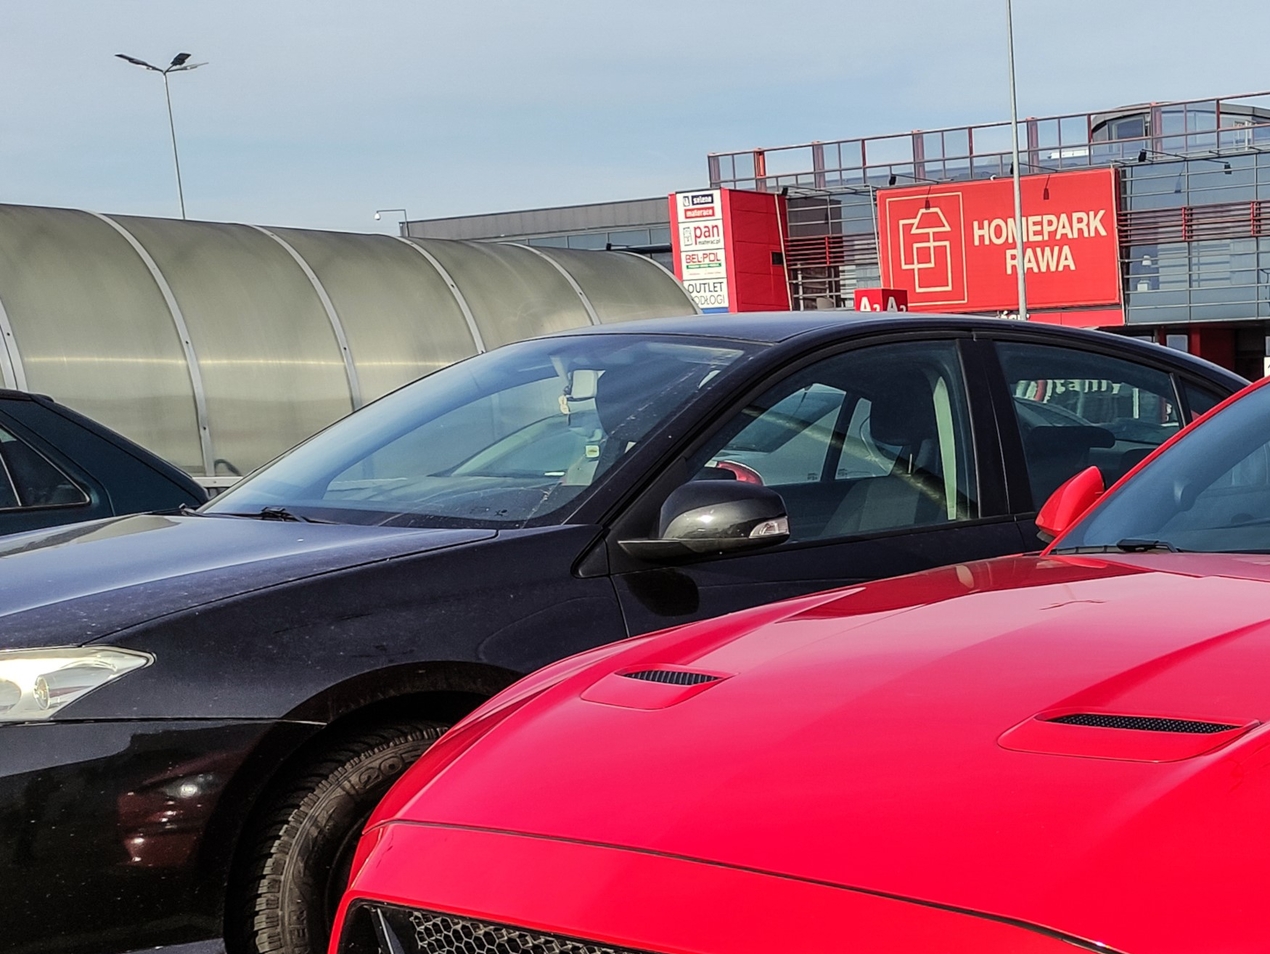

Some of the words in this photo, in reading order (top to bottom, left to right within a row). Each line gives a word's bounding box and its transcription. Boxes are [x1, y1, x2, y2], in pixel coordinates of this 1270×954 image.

[693, 224, 720, 246] pan
[973, 210, 1107, 246] HOMEPARK
[685, 252, 721, 264] BEL-POL
[1005, 245, 1075, 275] RAWA
[687, 281, 724, 294] OUTLET
[692, 294, 726, 306] ODŁOGI
